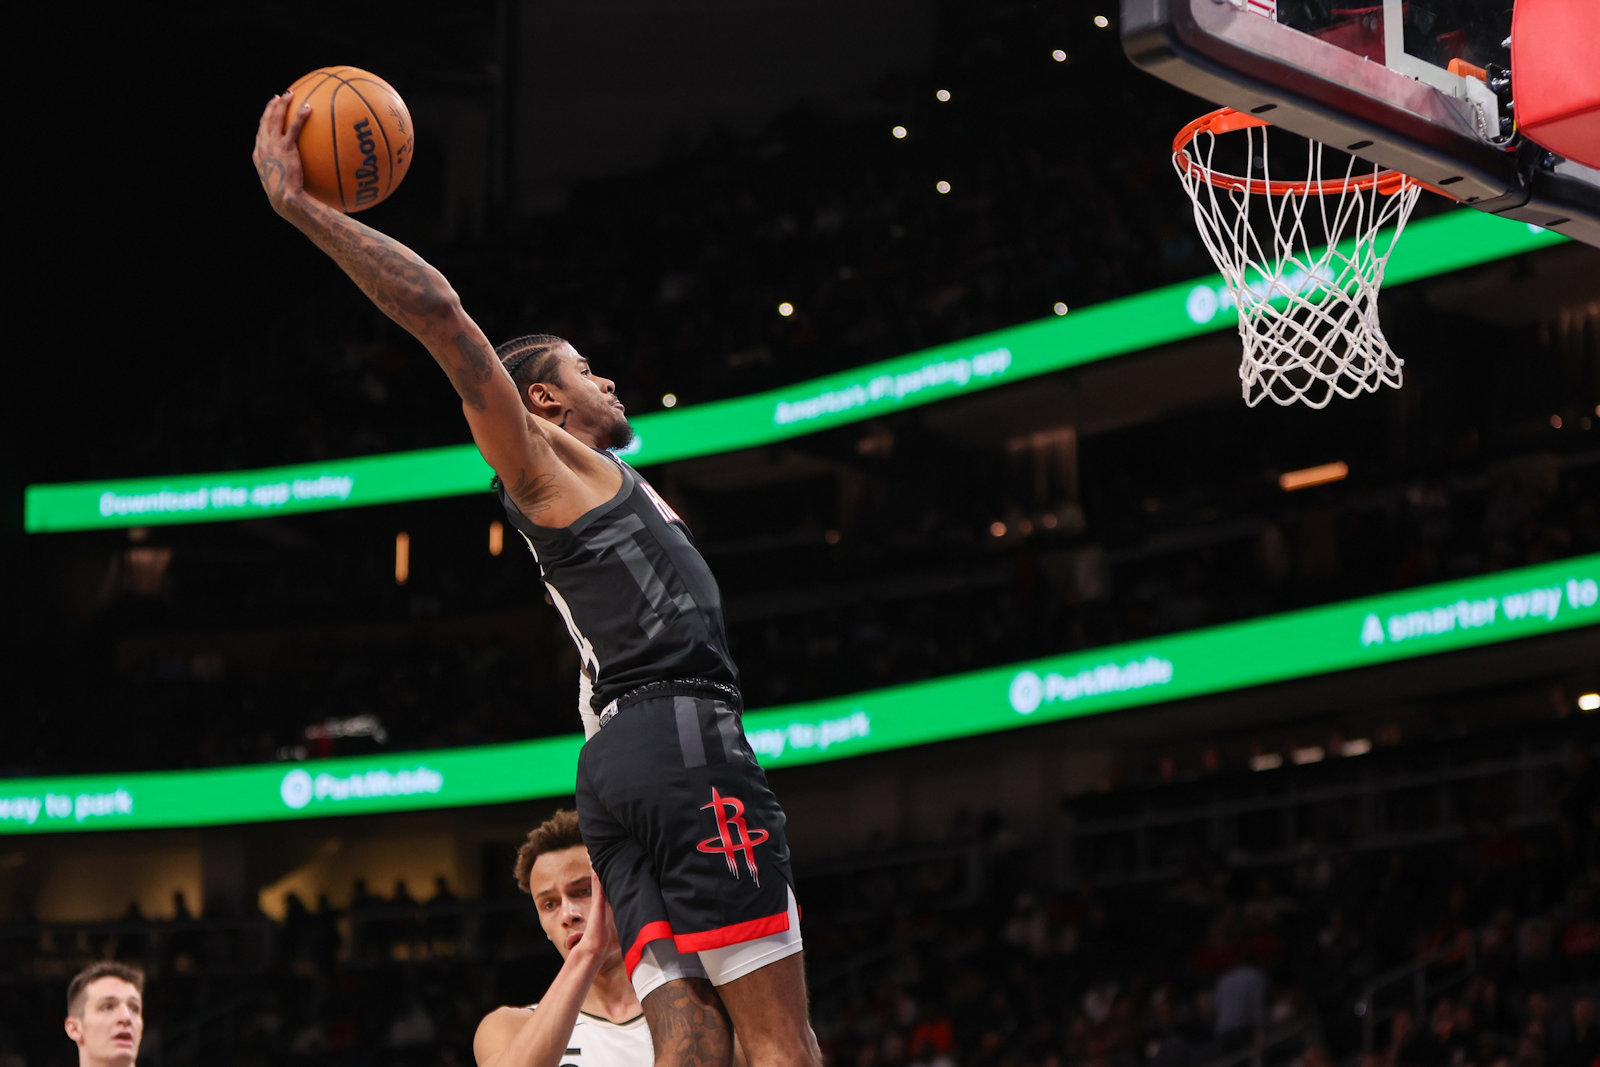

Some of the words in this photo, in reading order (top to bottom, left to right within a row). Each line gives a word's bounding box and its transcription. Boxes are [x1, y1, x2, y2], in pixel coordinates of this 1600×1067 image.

[355, 118, 377, 206] Wilson
[894, 360, 971, 396] parking
[973, 350, 1010, 375] app
[100, 488, 209, 515] Download
[211, 484, 248, 506] the
[251, 483, 290, 506] app
[292, 476, 352, 499] today
[1362, 615, 1385, 645] A
[1388, 599, 1497, 641] smarter
[1503, 589, 1561, 620] way
[1566, 580, 1598, 608] to
[787, 722, 815, 749] to
[816, 712, 870, 750] park
[46, 795, 72, 816] to
[75, 789, 133, 821] park
